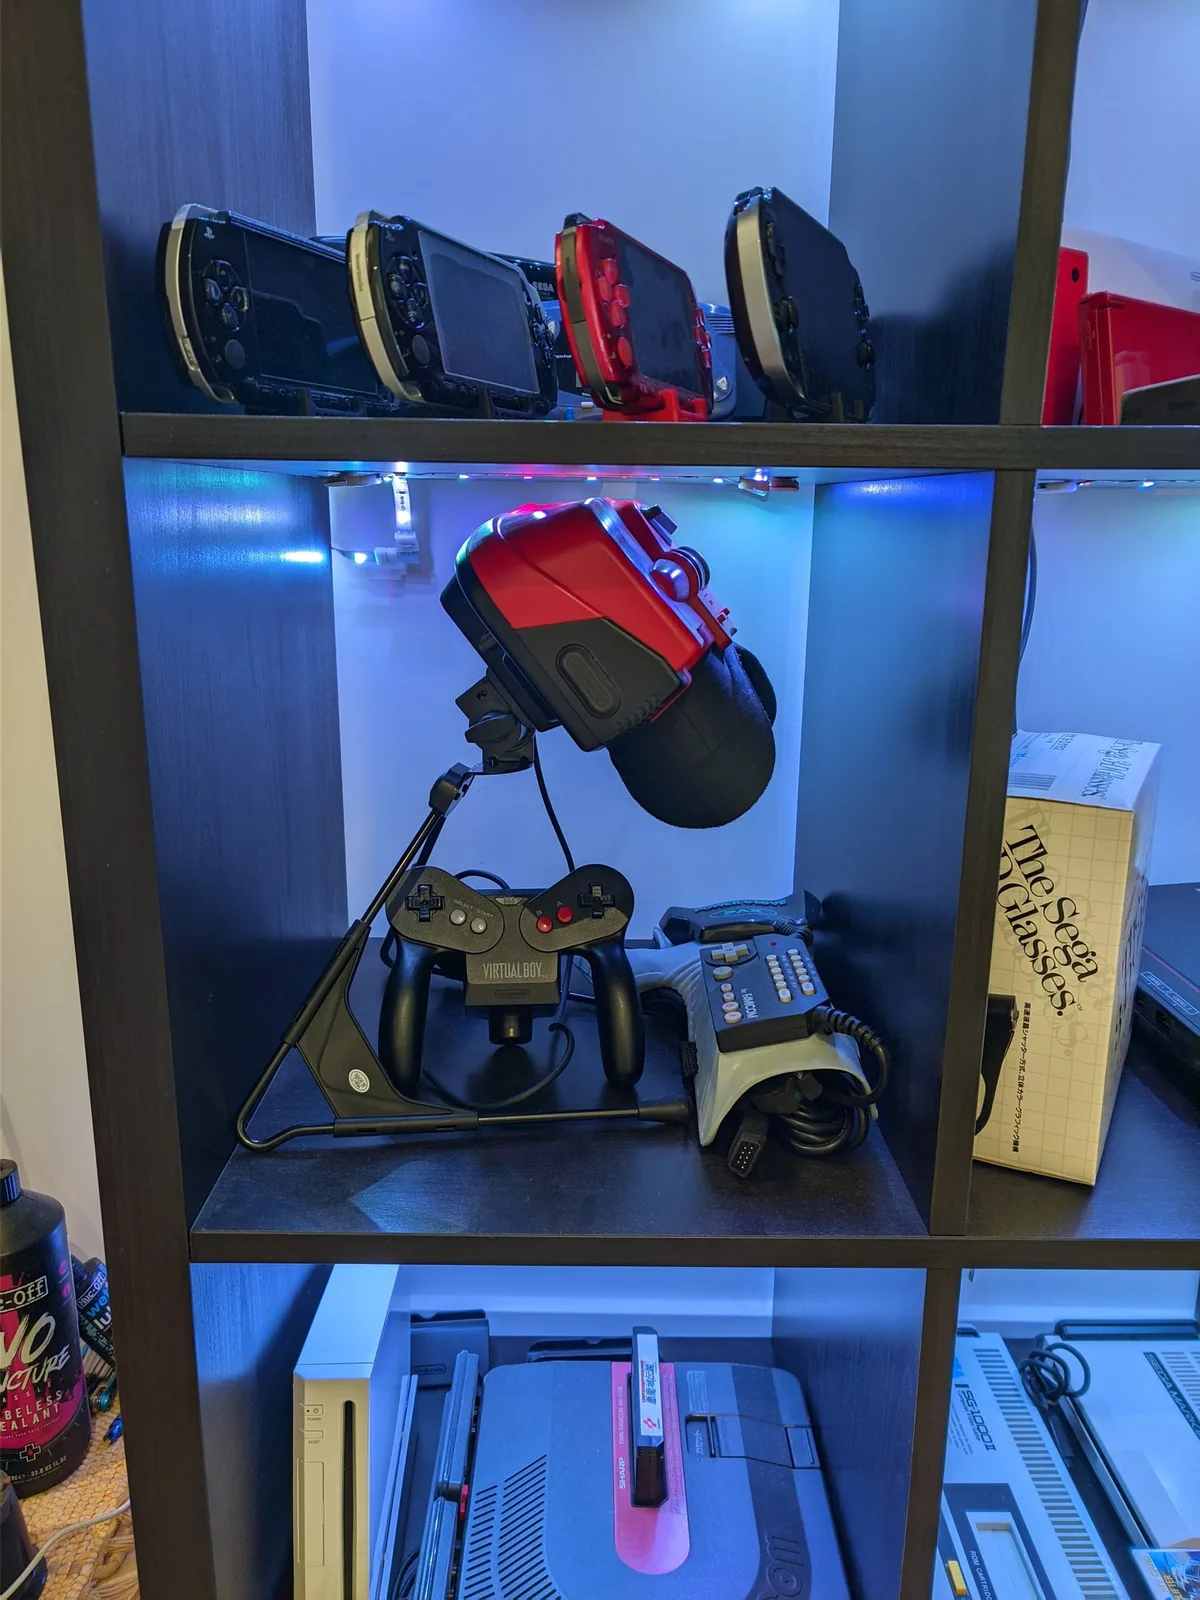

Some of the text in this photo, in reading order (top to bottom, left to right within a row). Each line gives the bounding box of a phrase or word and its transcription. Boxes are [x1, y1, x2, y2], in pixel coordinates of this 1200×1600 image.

[453, 899, 494, 918] SELECT START
[1005, 824, 1055, 898] The
[1040, 896, 1099, 983] Sega
[482, 962, 542, 979] VIRTUAL BOY
[94, 1305, 112, 1330] lu
[970, 1550, 980, 1566] ROM
